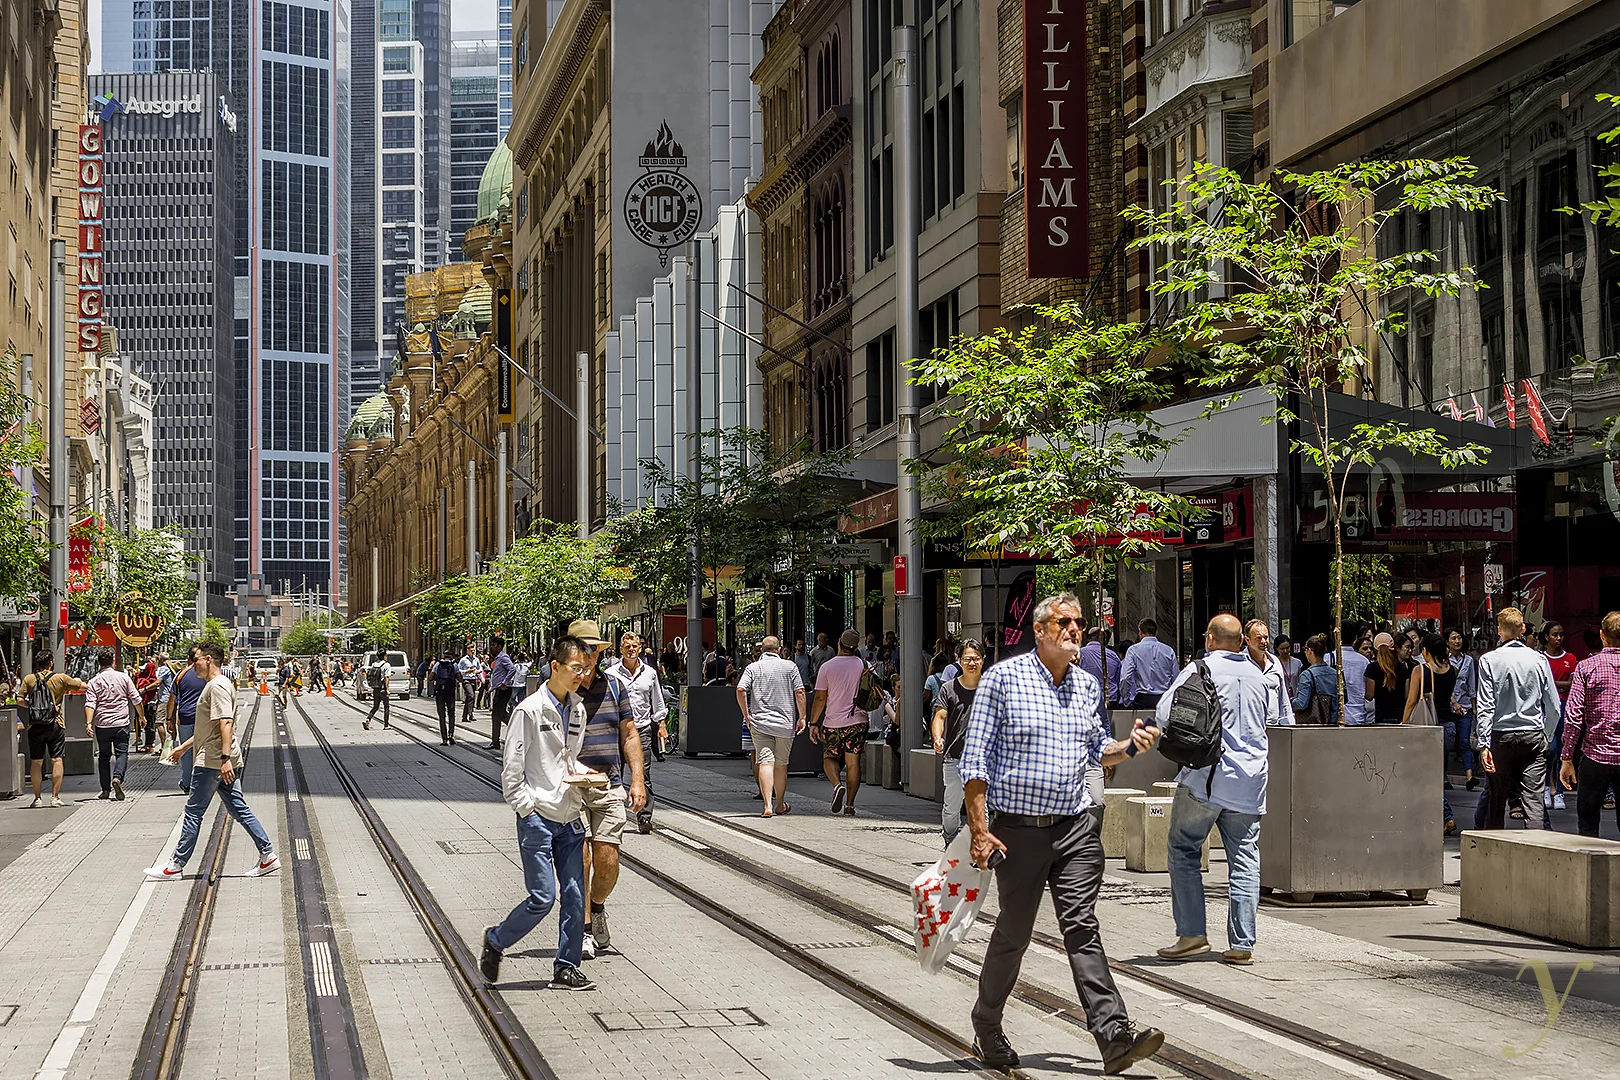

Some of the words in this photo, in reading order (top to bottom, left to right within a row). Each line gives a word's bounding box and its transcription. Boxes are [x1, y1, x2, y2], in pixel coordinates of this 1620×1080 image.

[124, 94, 201, 118] Ausgrid
[637, 174, 688, 192] HEALTH
[645, 195, 681, 223] HCF
[81, 127, 100, 350] GOWINGS
[628, 209, 653, 241] CARE
[672, 209, 698, 241] FUND
